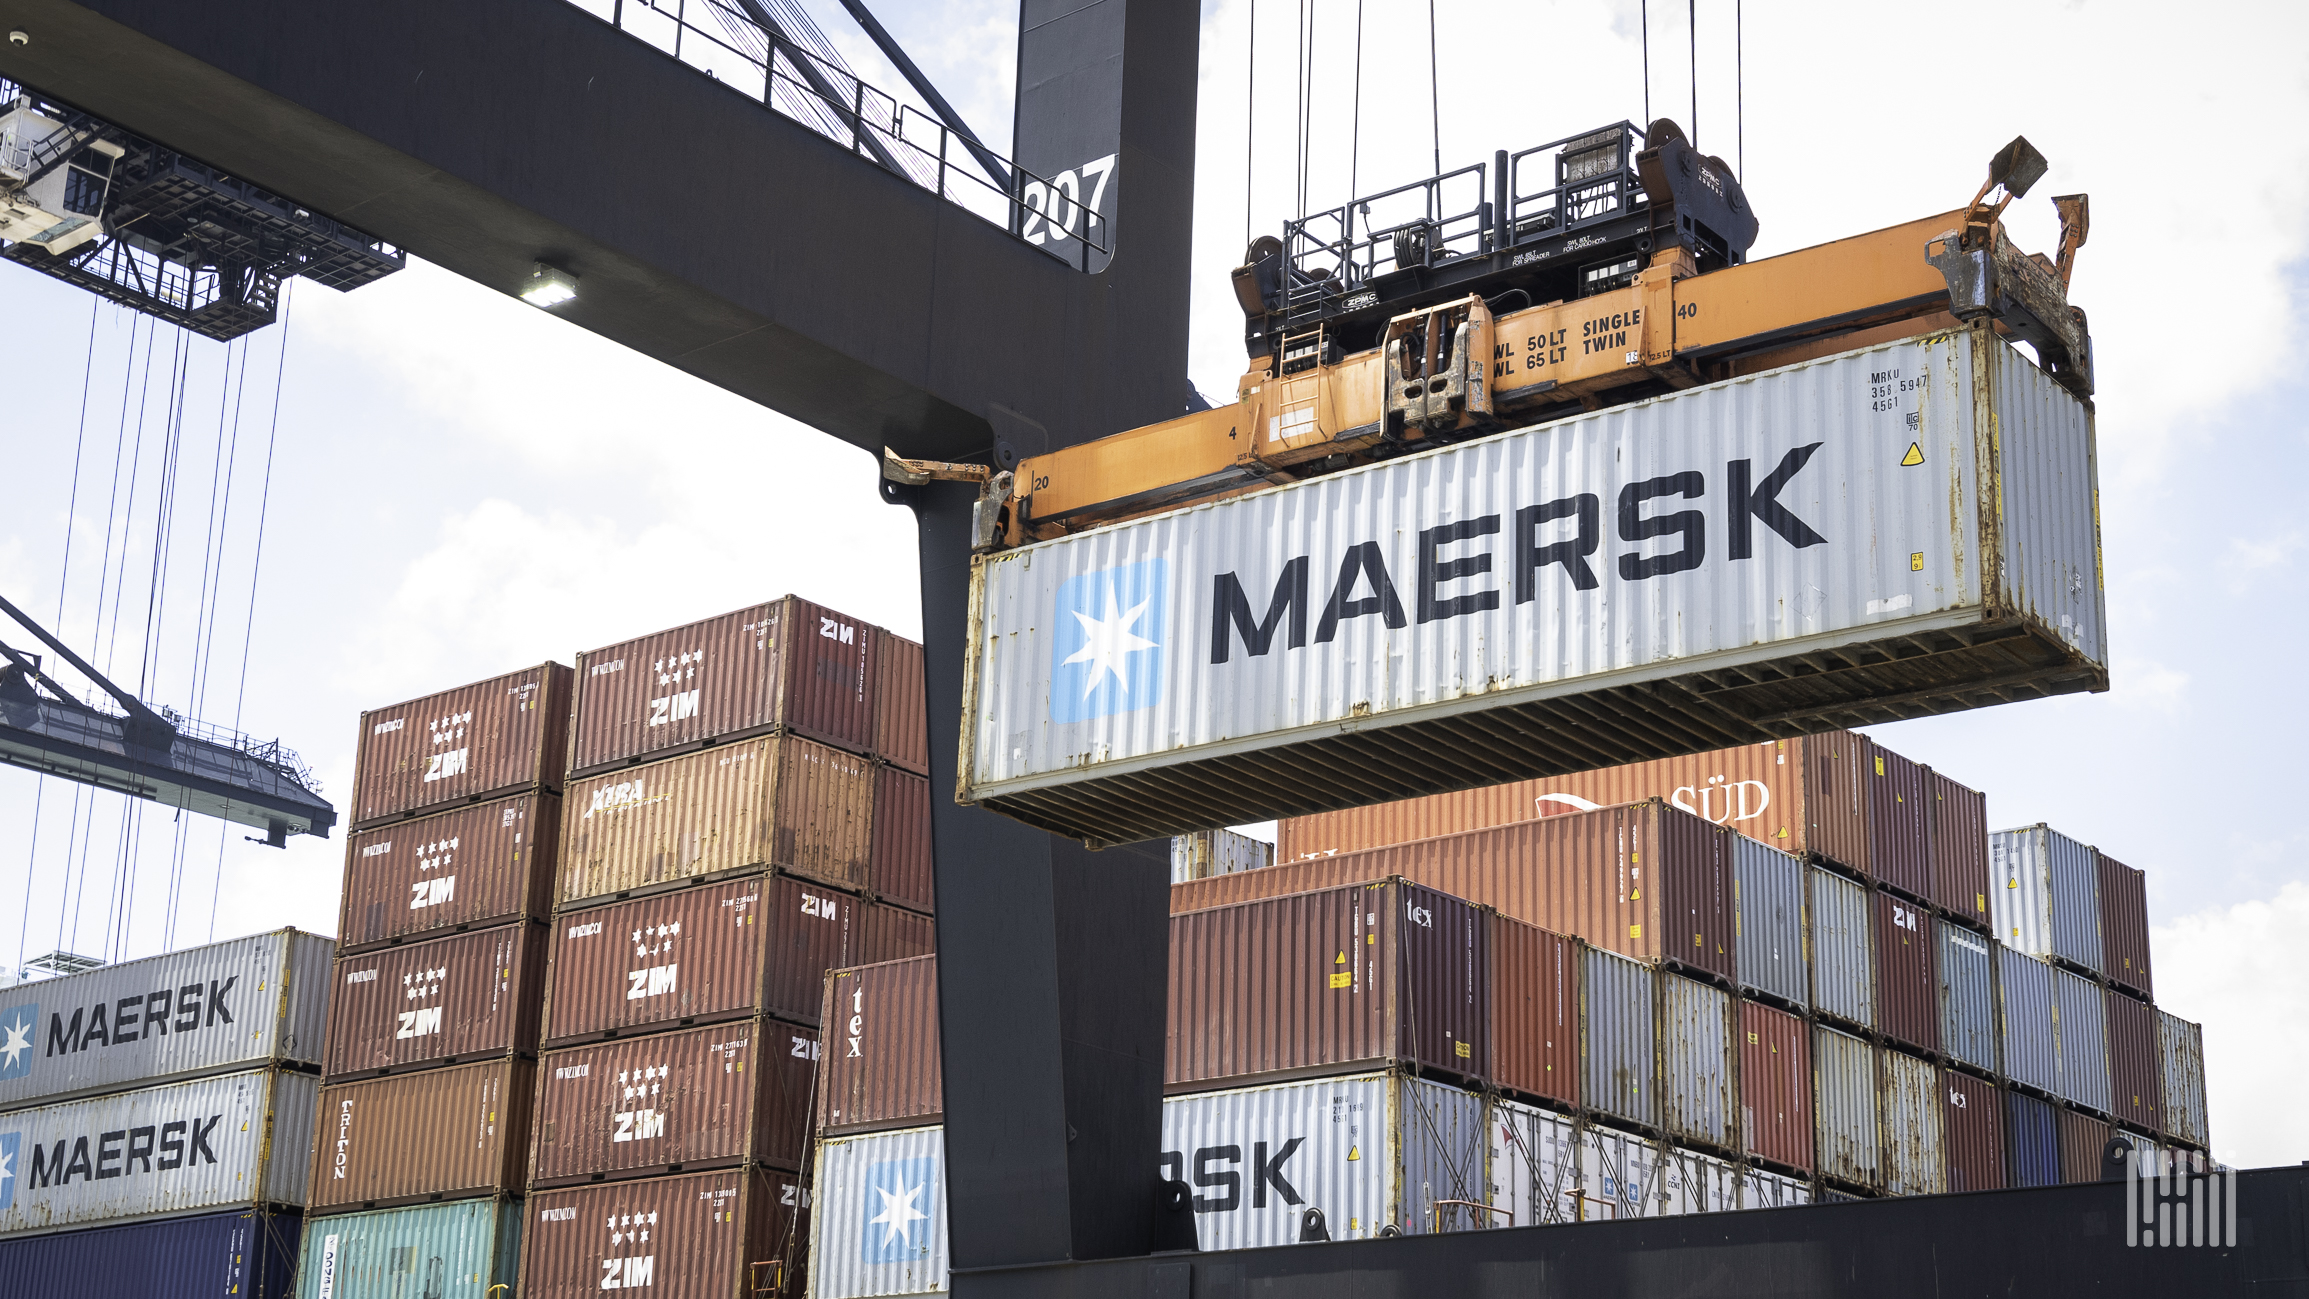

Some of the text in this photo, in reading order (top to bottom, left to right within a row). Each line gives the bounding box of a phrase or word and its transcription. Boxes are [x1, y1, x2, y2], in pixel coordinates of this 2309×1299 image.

[1701, 167, 1720, 185] ZPMC
[1023, 153, 1115, 245] 207
[1524, 251, 1550, 263] SPREADER
[1347, 294, 1376, 307] ZPMC
[1678, 302, 1697, 320] 40
[1583, 309, 1640, 337] SINGLE
[1583, 331, 1627, 355] TWIN
[1871, 369, 1899, 384] MRKU
[1872, 375, 1927, 398] 358 5947
[1872, 396, 1898, 412] 45G1
[1034, 475, 1049, 491] 20
[1211, 441, 1829, 665] MAERSK
[820, 616, 854, 646] ZIM
[649, 688, 700, 727] ZIM
[424, 747, 468, 783] ZIM
[1671, 774, 1769, 825] SÜD
[409, 875, 455, 910] ZIM
[801, 892, 836, 921] ZIM
[1407, 898, 1432, 929] tex
[1893, 905, 1917, 932] ZIM
[627, 964, 677, 1001] ZIM
[46, 975, 239, 1057] MAERSK
[396, 1005, 442, 1040] ZIM
[846, 986, 863, 1058] tex
[333, 1099, 353, 1180] TRITON
[613, 1108, 665, 1143] ZIM
[29, 1114, 223, 1190] MAERSK
[600, 1255, 654, 1291] ZIM
